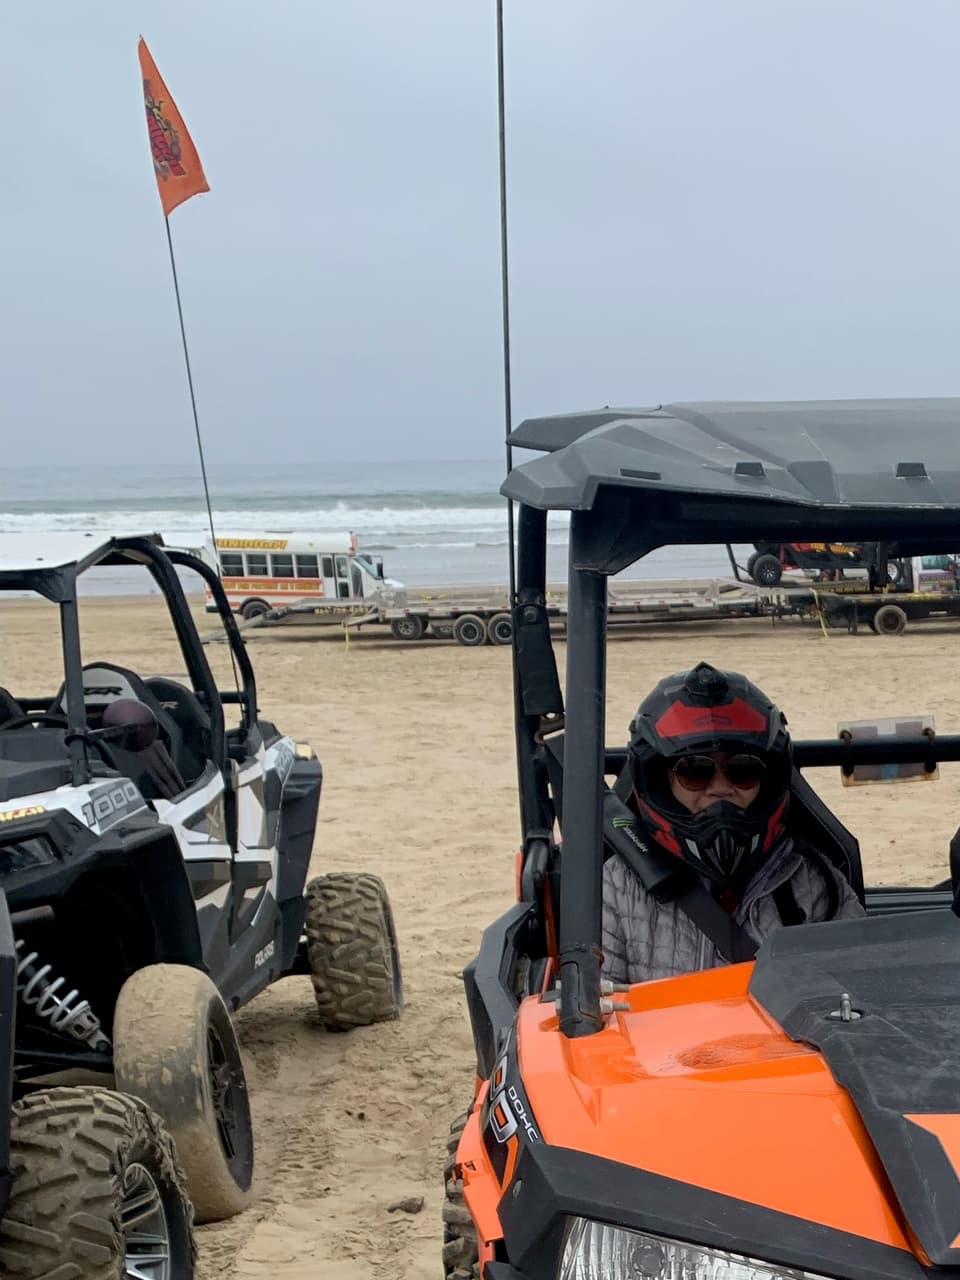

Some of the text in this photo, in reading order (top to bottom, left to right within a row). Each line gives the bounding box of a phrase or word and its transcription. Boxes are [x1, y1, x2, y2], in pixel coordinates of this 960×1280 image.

[81, 782, 138, 827] 1000
[254, 940, 274, 969] POLARIS
[508, 1085, 539, 1143] DOHC
